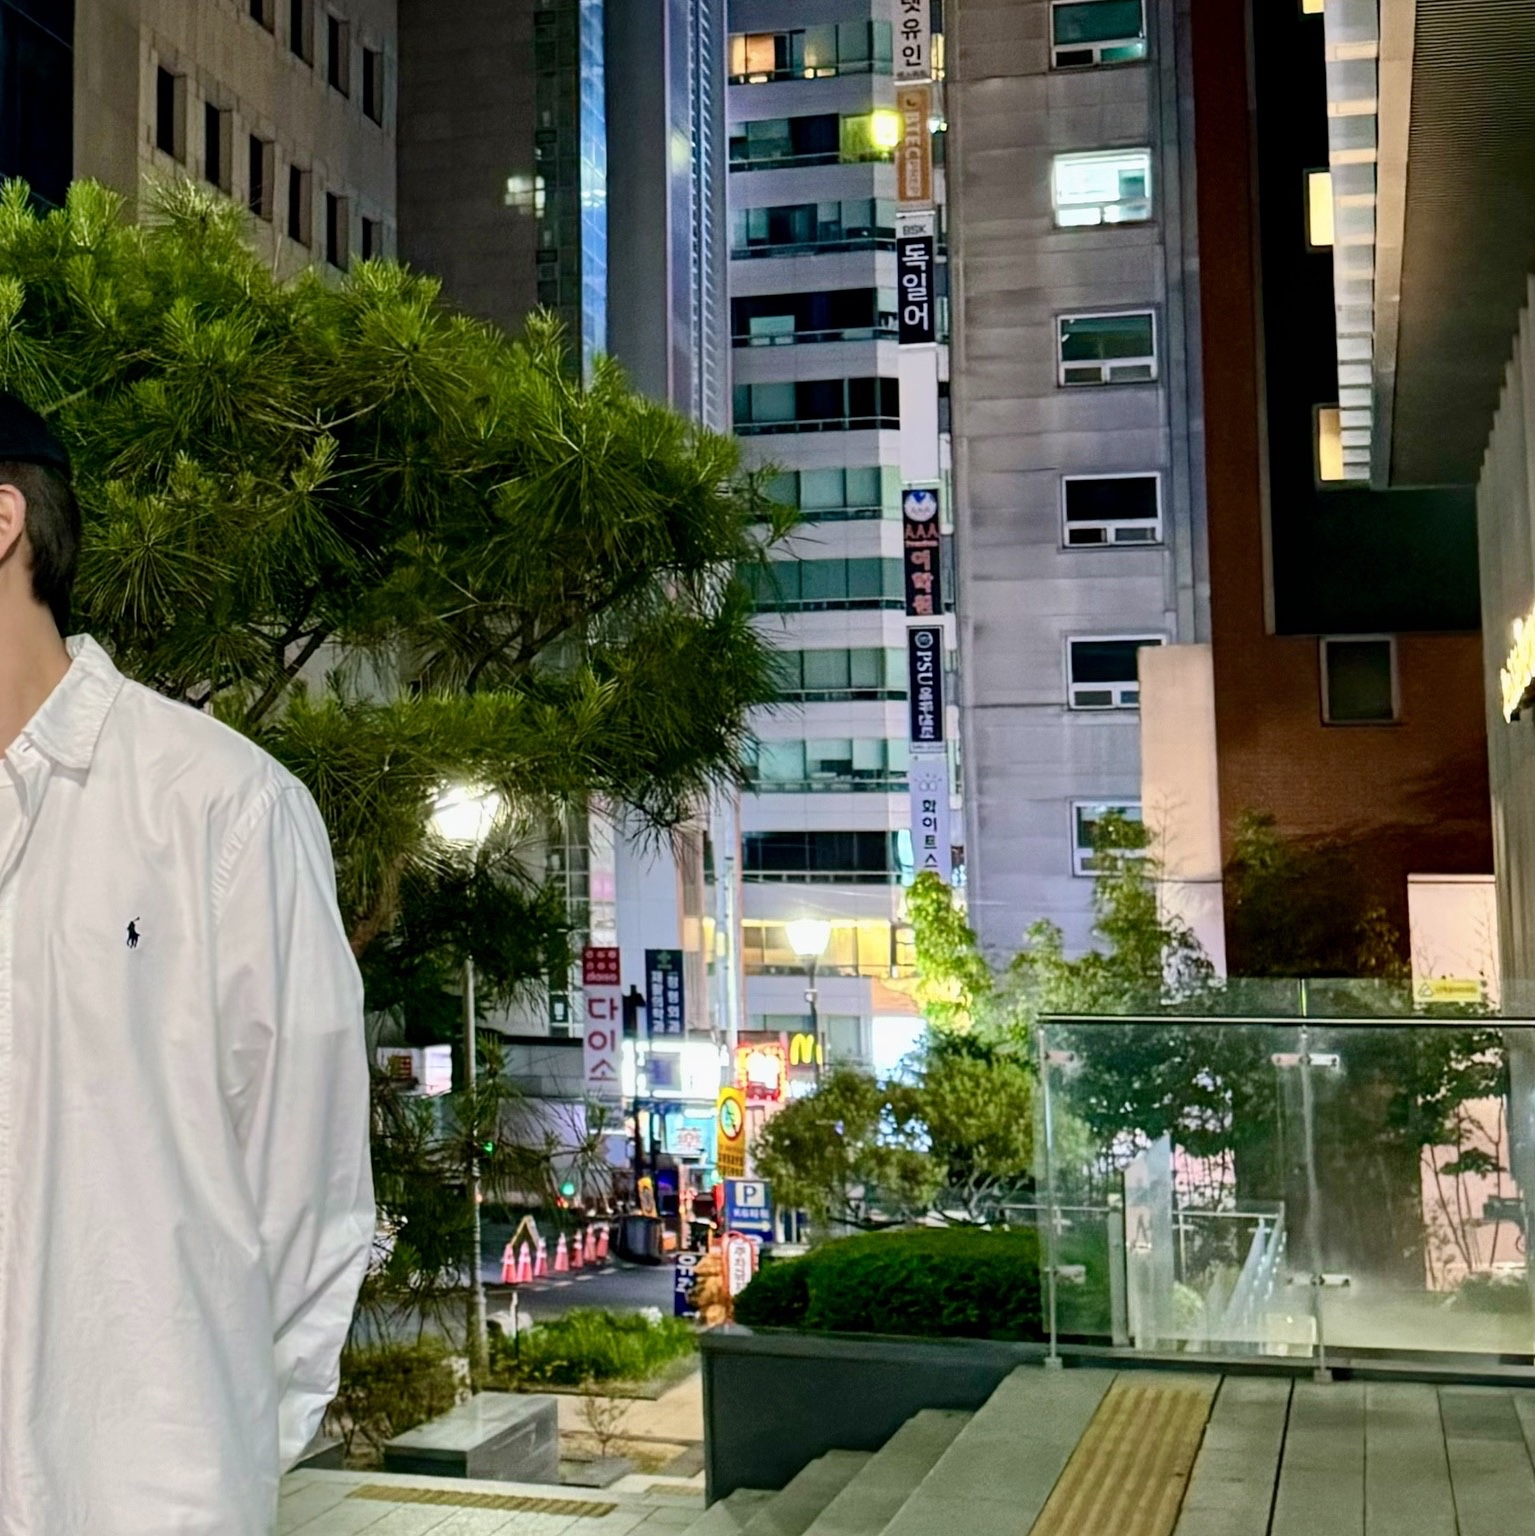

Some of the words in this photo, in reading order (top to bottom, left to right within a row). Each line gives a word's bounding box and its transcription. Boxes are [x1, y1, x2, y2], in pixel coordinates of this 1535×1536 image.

[901, 243, 929, 331] 독일어
[904, 522, 939, 539] AAA
[916, 651, 933, 686] PSU
[587, 997, 619, 1082] 다이소
[743, 1185, 757, 1205] P
